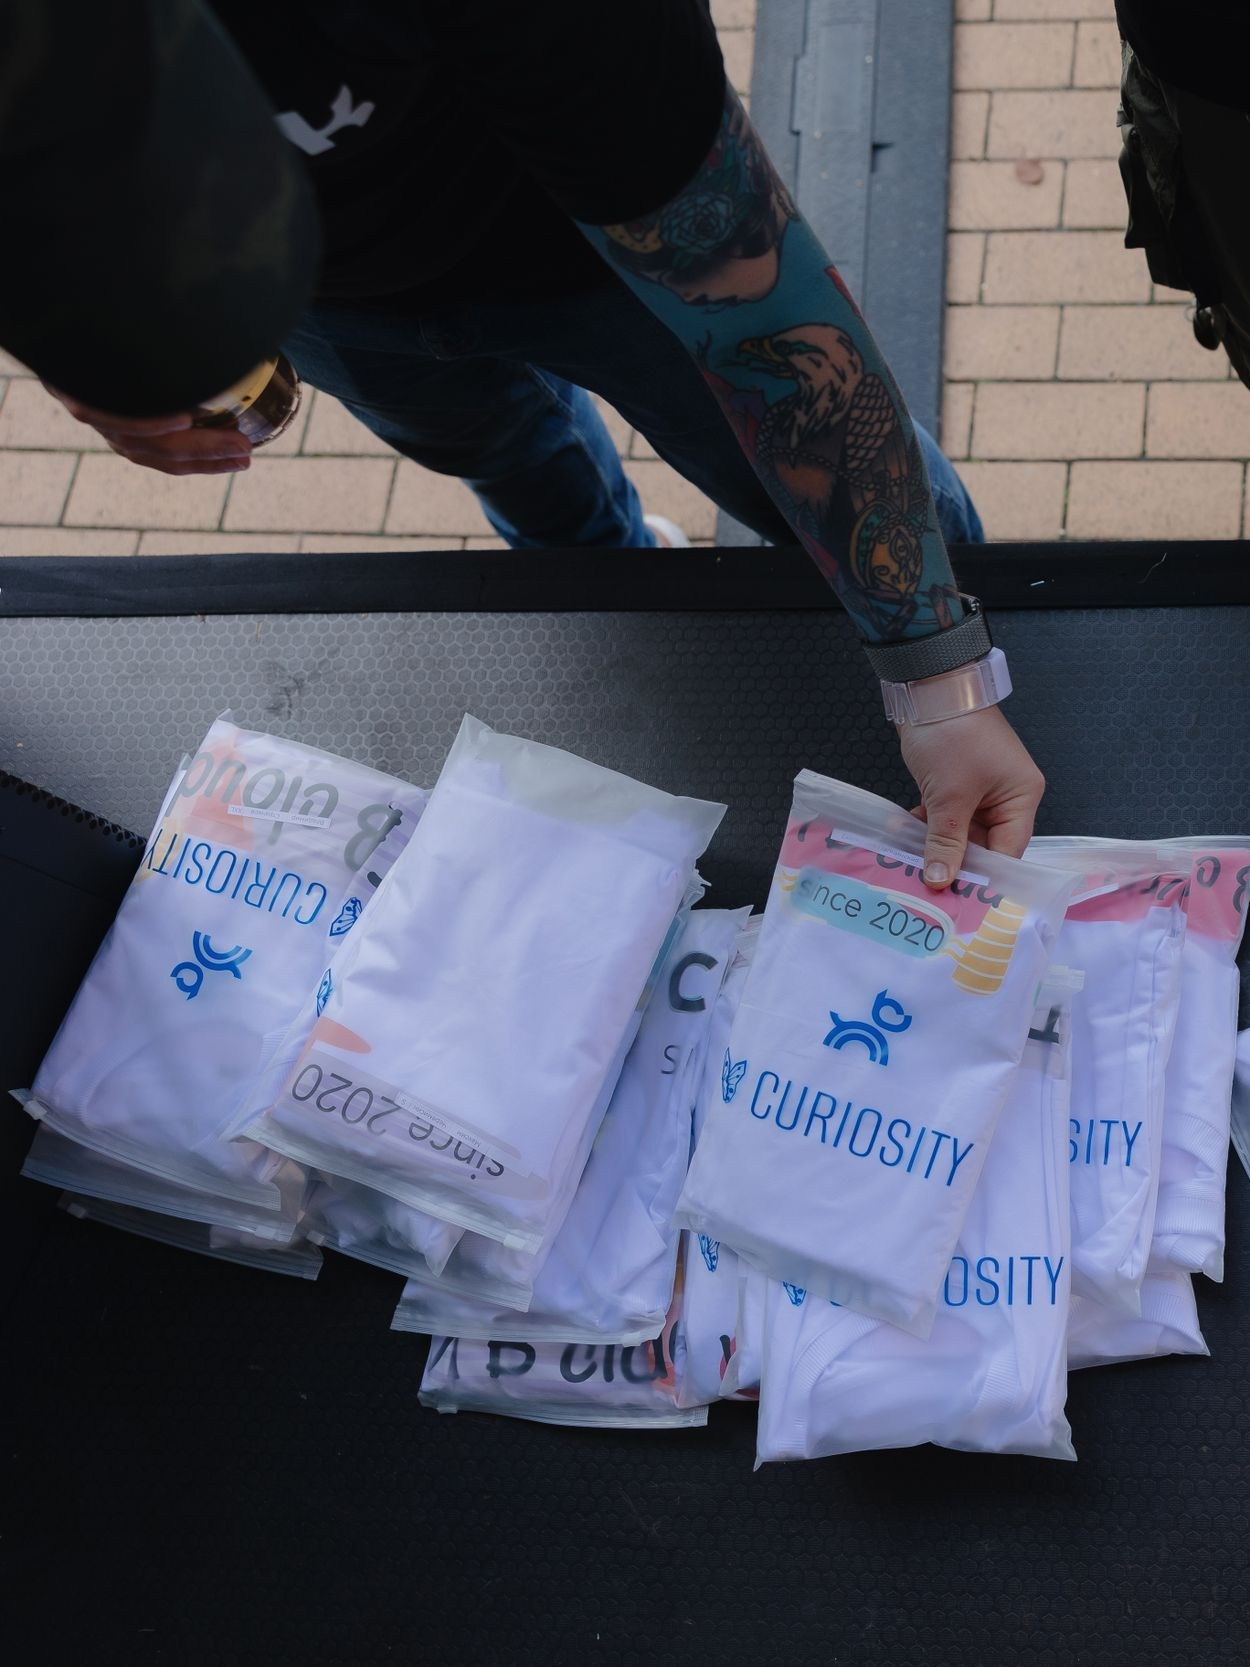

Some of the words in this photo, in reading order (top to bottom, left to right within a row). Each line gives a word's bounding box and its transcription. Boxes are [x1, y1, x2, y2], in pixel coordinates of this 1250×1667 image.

[140, 828, 328, 925] CURIOSITY
[869, 901, 946, 952] 2020
[291, 1063, 402, 1137] 2020
[750, 1069, 975, 1187] CURIOSITY
[408, 1116, 505, 1180] since
